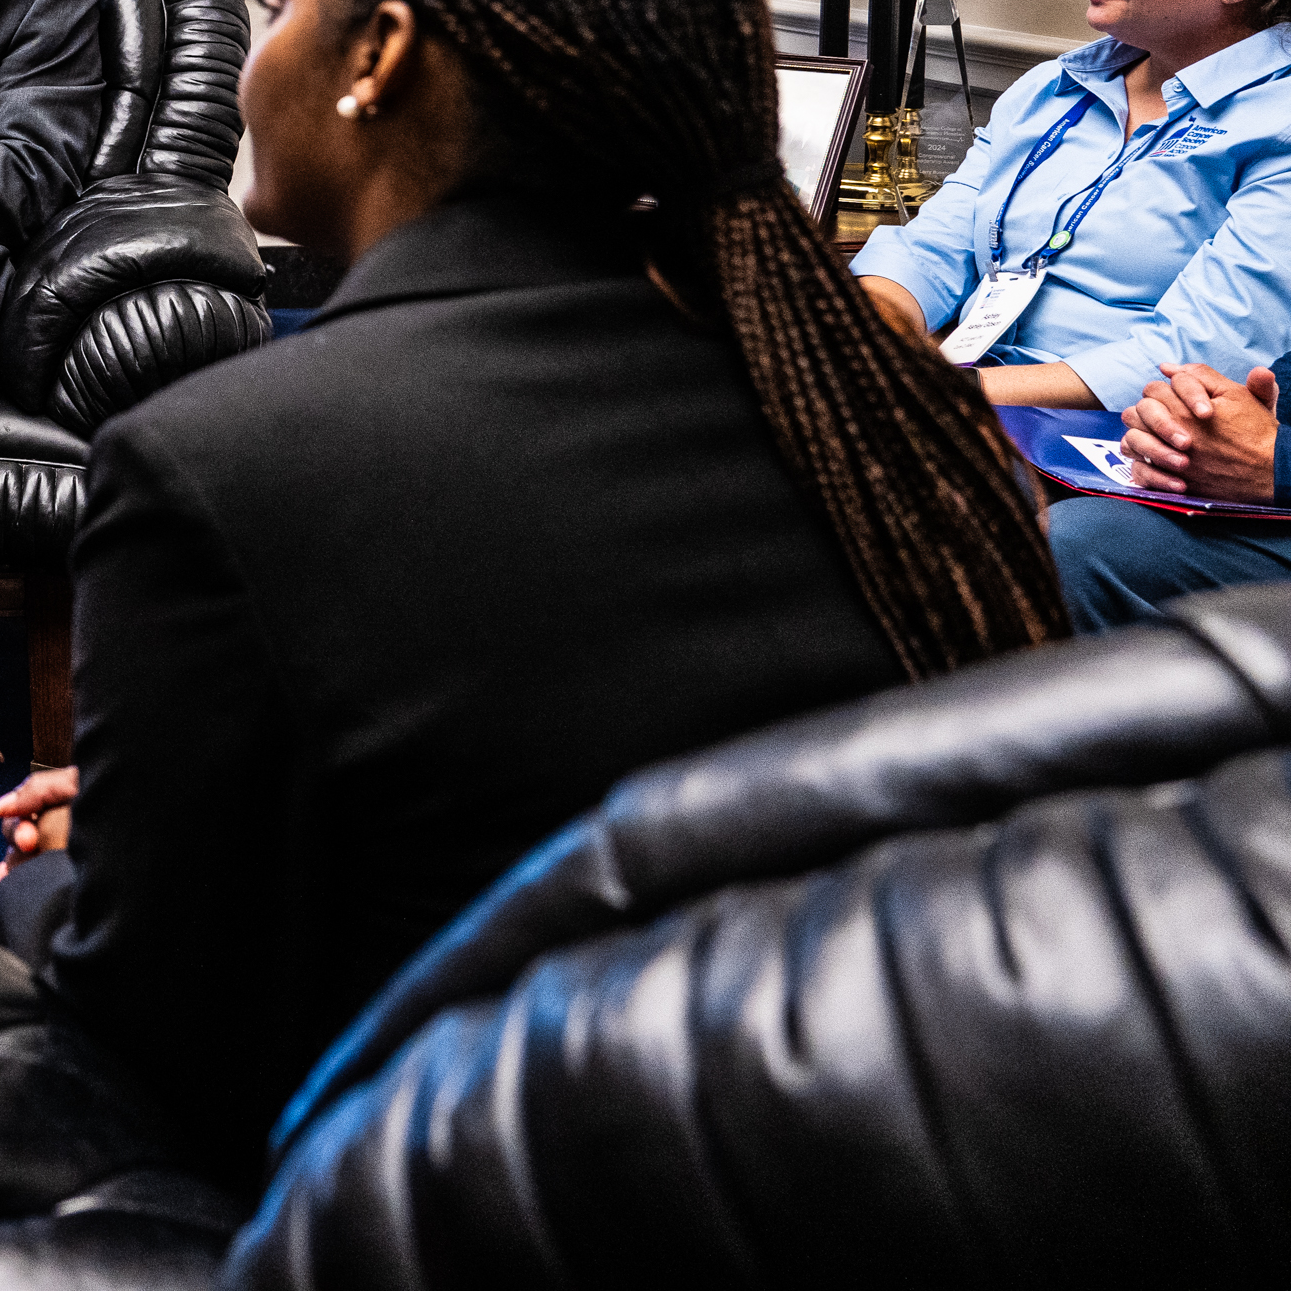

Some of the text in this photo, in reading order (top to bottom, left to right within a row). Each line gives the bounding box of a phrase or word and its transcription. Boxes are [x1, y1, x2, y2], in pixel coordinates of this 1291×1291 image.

[1048, 119, 1071, 142] American
[1187, 131, 1213, 139] Cancer
[1191, 125, 1228, 135] American
[1181, 137, 1208, 145] Society
[1033, 141, 1052, 161] Cancer
[1081, 189, 1100, 210] Cancer
